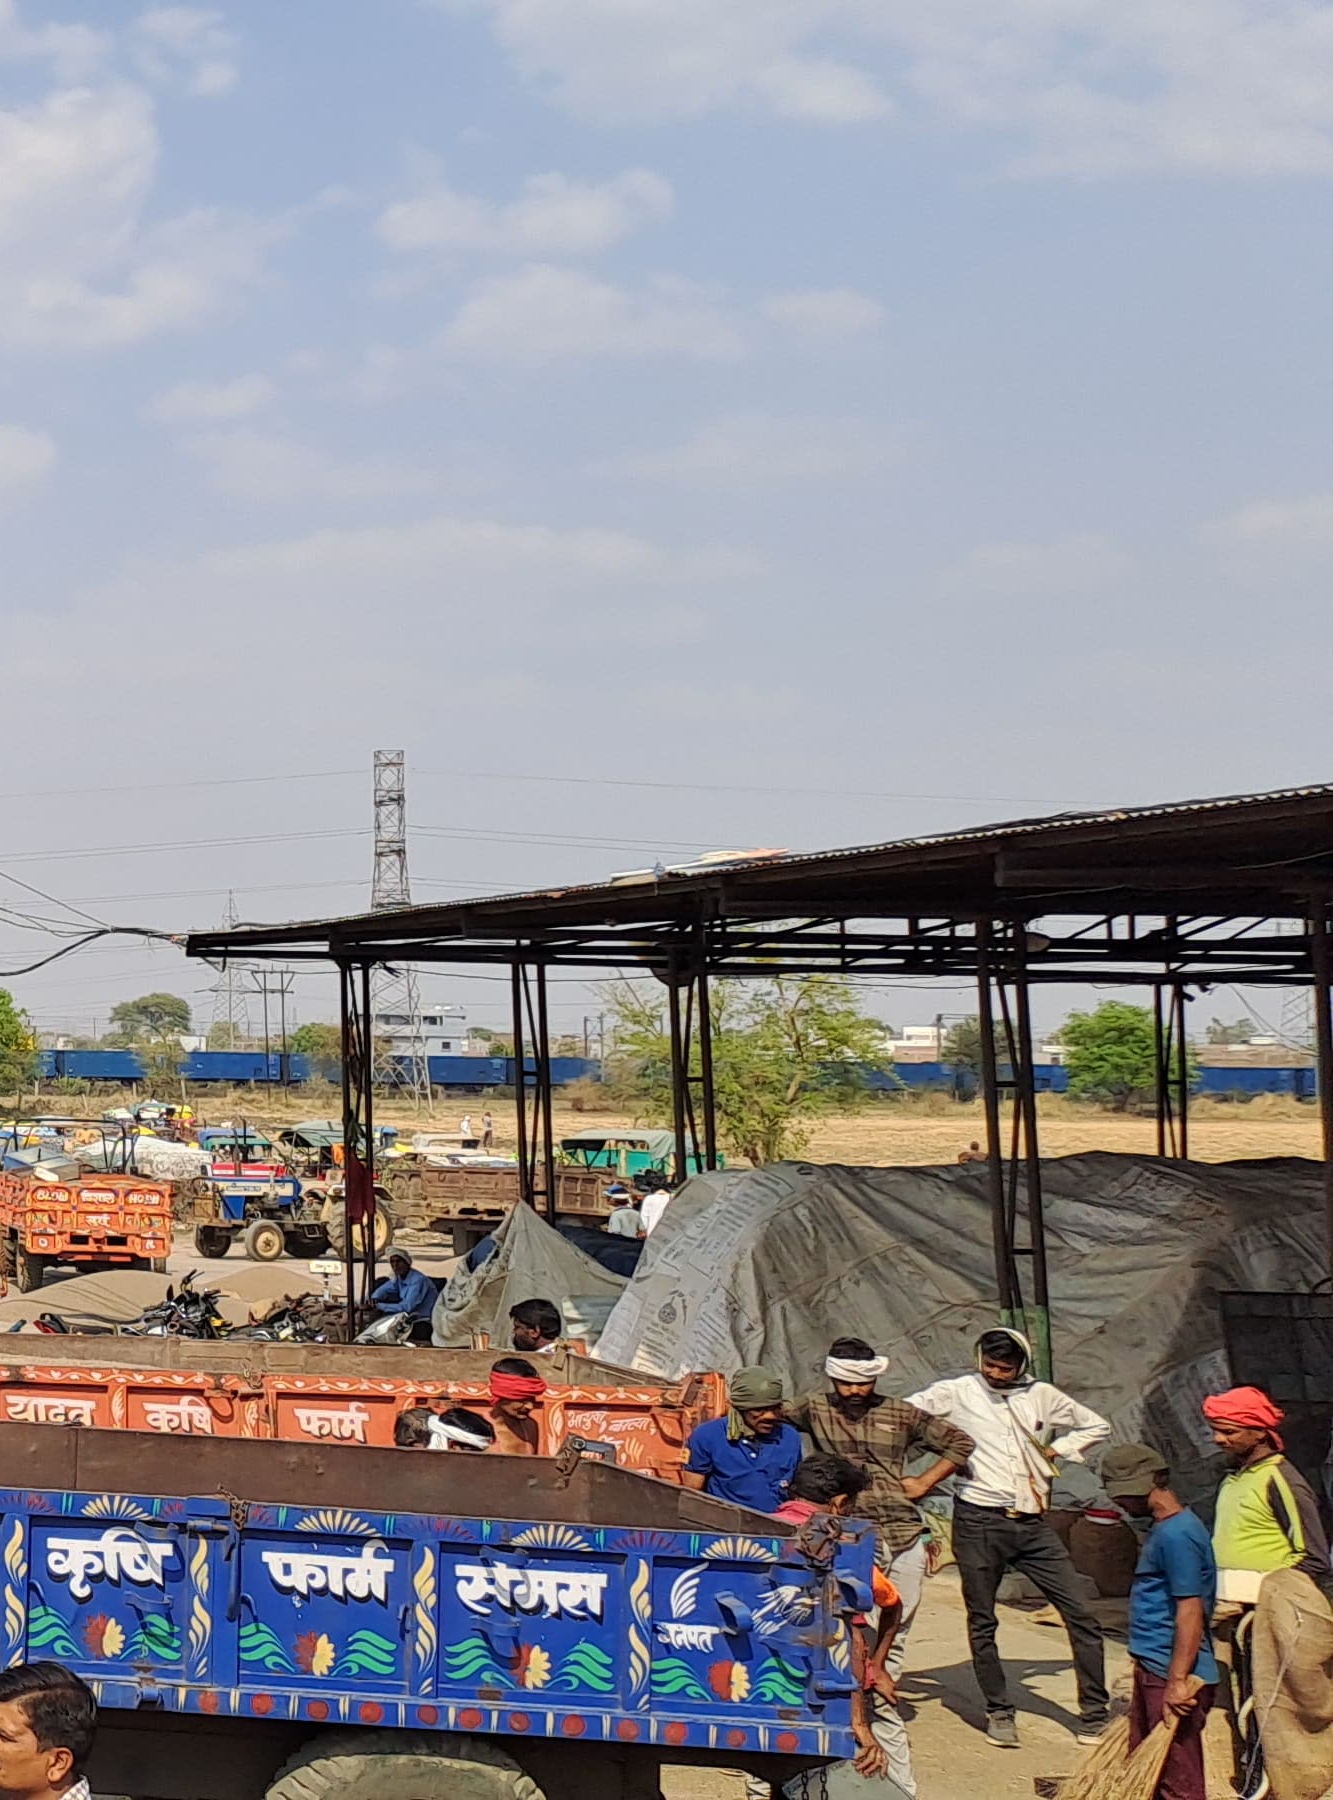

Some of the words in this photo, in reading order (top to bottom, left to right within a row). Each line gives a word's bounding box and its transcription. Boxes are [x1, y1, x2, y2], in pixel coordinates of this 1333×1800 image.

[4, 1394, 96, 1426] यादव
[141, 1396, 213, 1434] कषि
[293, 1401, 370, 1442] फार्म
[46, 1526, 175, 1598] कृषि
[261, 1538, 394, 1601] फार्म
